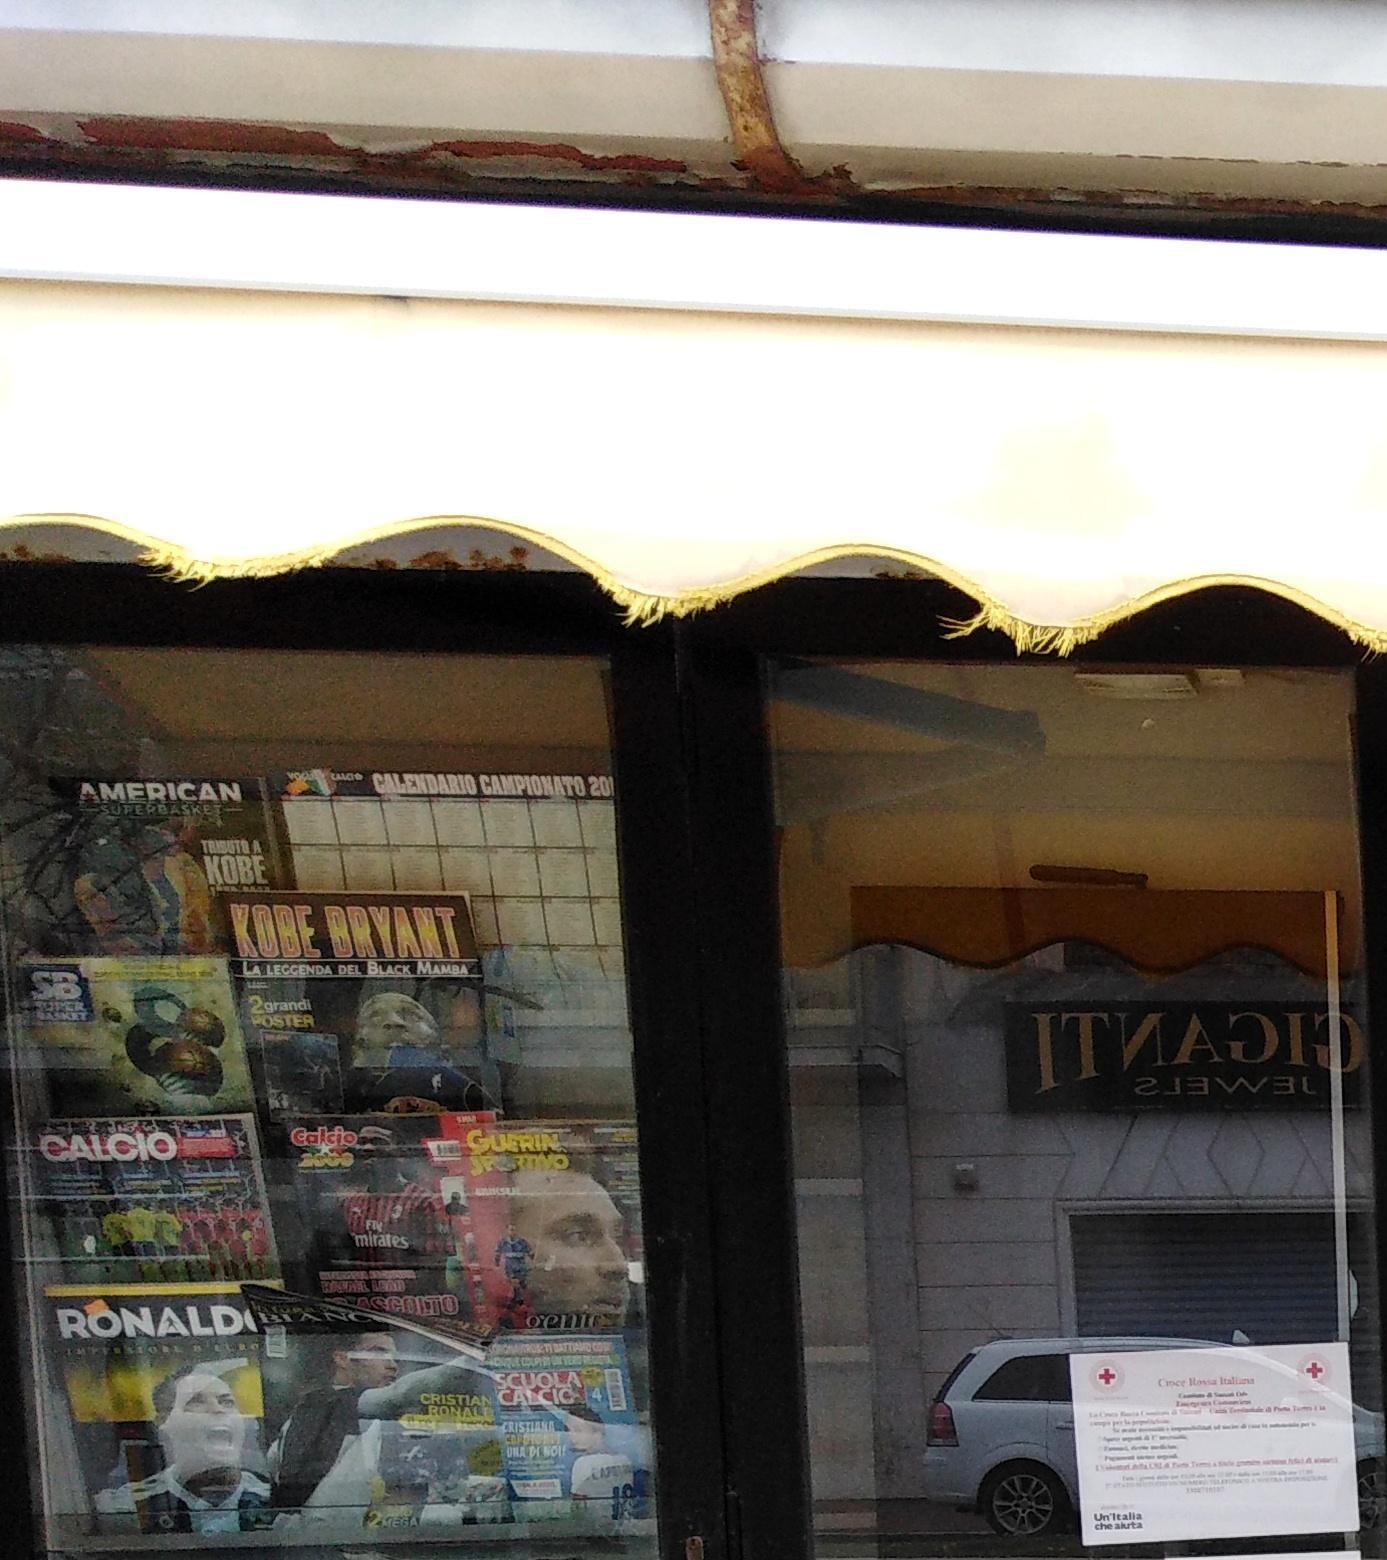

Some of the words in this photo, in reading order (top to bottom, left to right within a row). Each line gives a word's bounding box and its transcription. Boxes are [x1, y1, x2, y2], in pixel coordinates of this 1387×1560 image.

[79, 782, 242, 803] AMERICAN
[372, 774, 478, 795] CALENDARIO
[479, 774, 587, 797] CAMPIONATO
[204, 855, 268, 885] KOBE
[230, 903, 321, 959] KOBE
[324, 905, 461, 959] BRYANT
[40, 1131, 178, 1163] CALCIO
[291, 1126, 358, 1147] Calcio
[495, 1371, 582, 1389] SCUOLA
